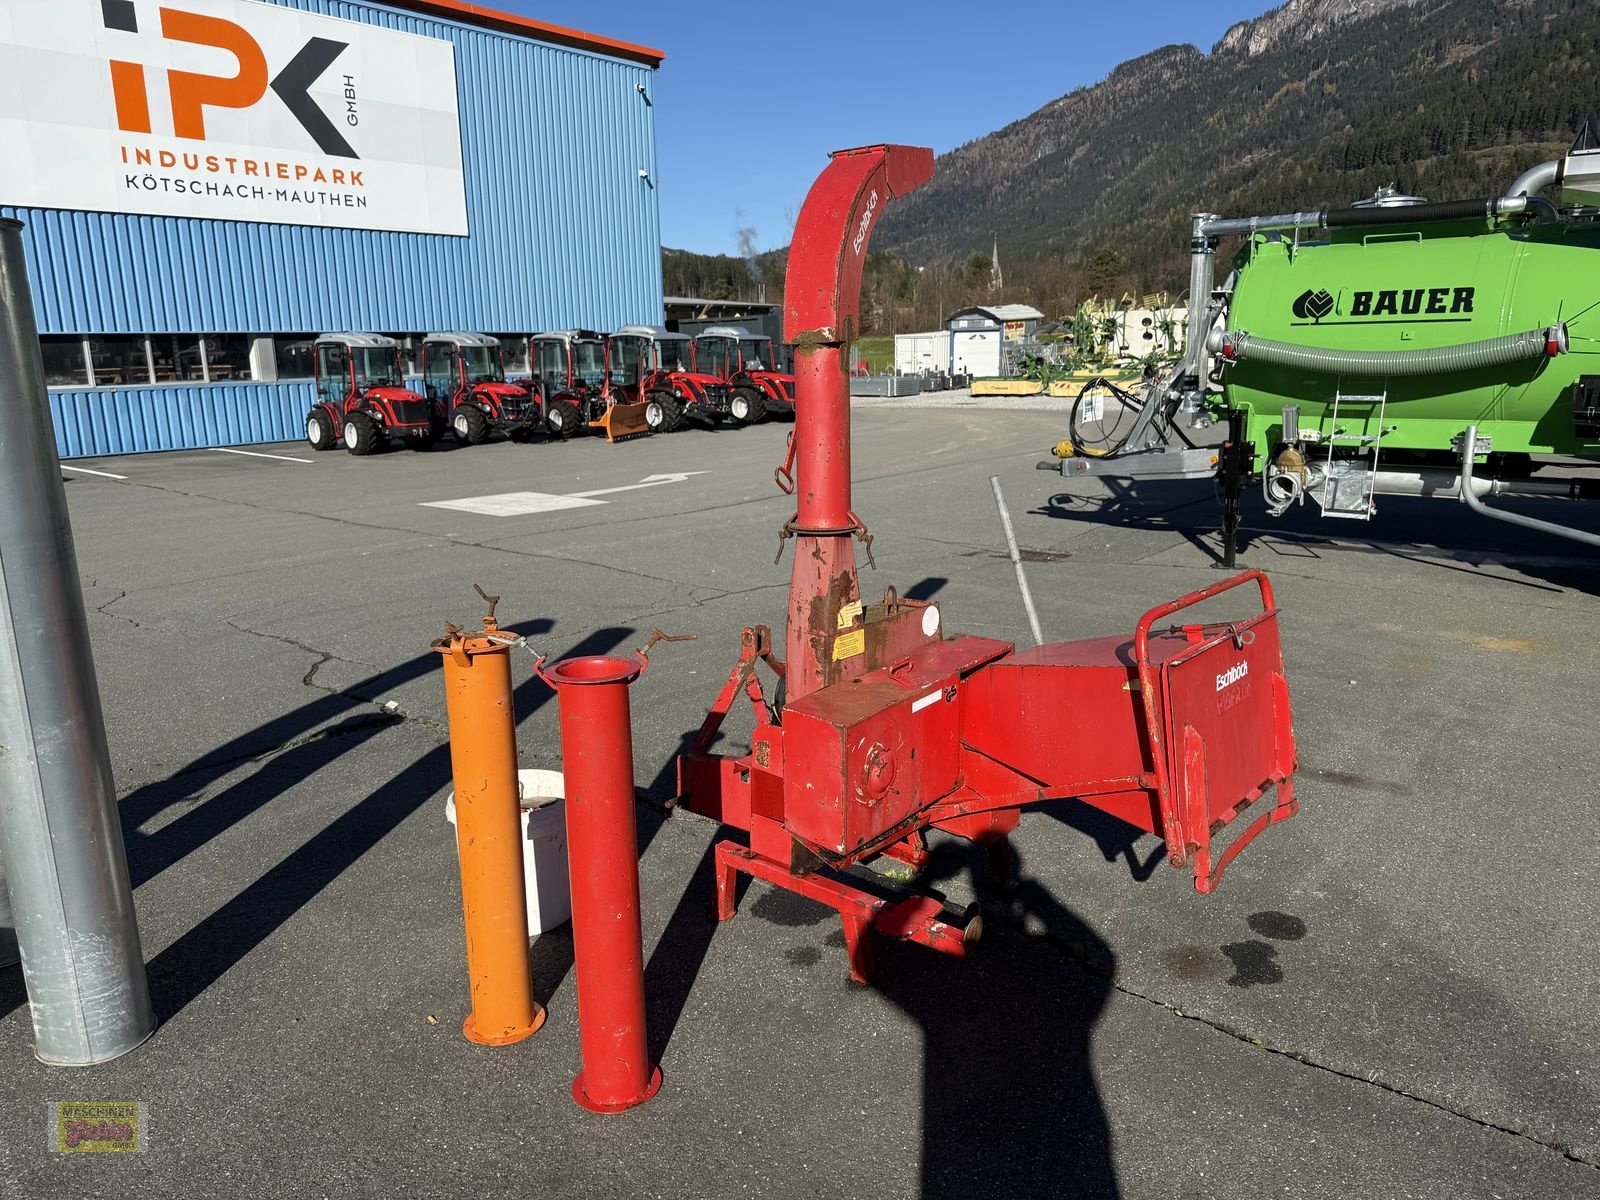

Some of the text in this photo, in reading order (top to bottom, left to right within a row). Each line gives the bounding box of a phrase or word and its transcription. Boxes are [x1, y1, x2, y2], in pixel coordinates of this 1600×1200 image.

[342, 74, 359, 127] GMBH
[121, 146, 364, 187] INDUSTRIEPARK
[125, 173, 367, 208] KÖTSCHACH-MAUTHEN
[1350, 287, 1475, 316] BAUER
[1216, 659, 1248, 692] Eschlböck
